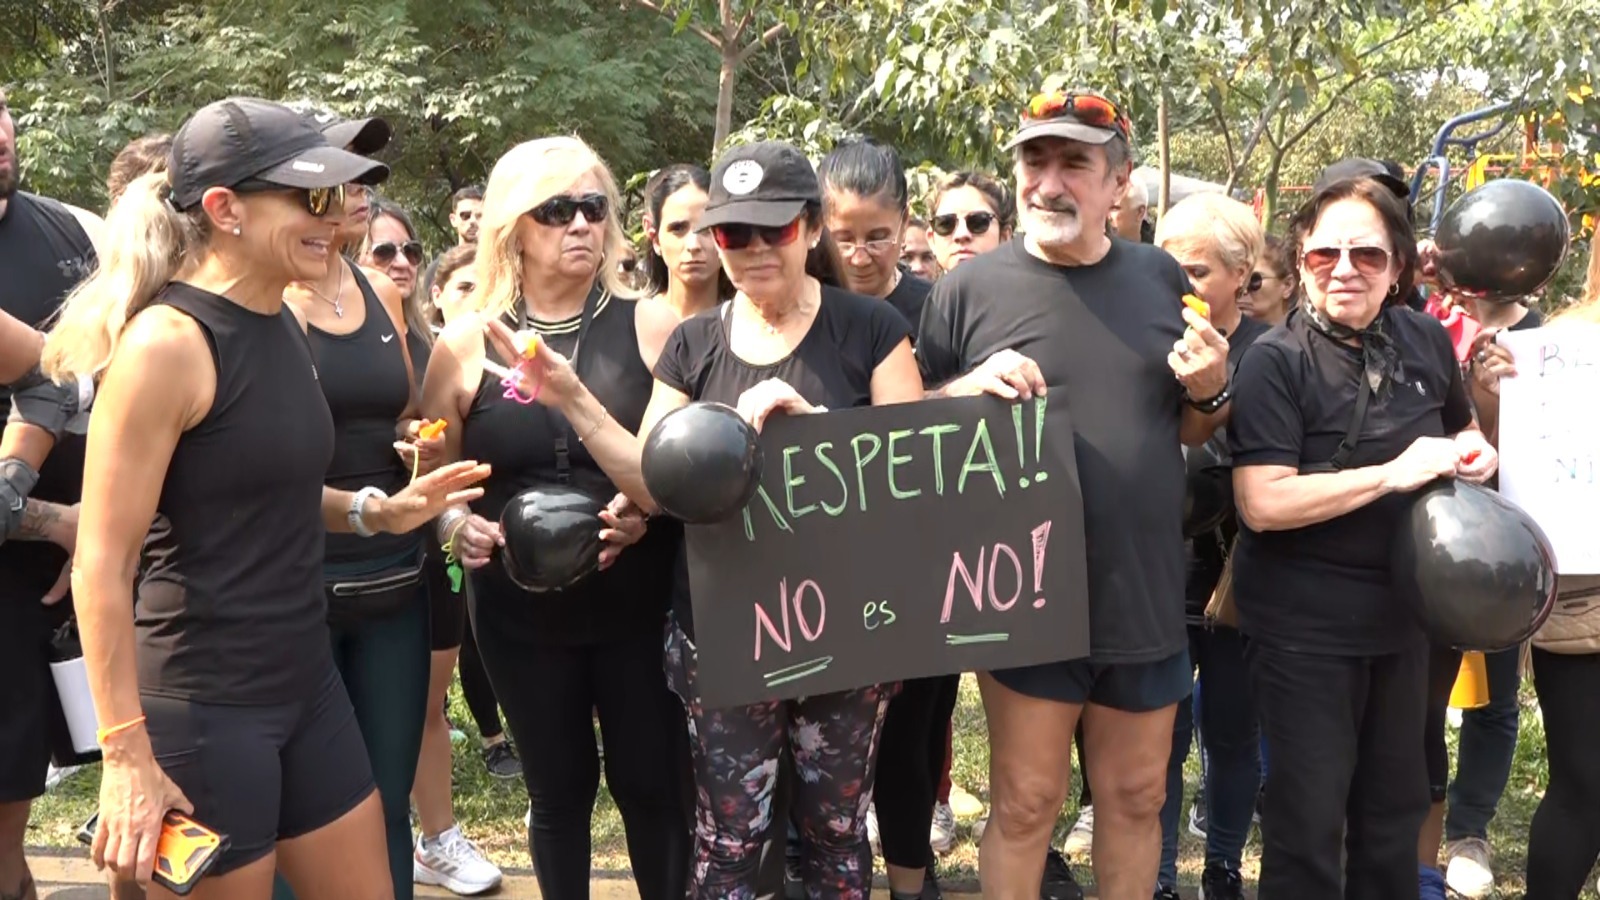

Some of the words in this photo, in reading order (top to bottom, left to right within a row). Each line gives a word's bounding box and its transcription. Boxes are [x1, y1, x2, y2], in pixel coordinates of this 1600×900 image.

[754, 577, 826, 661] NO
[863, 600, 896, 630] es
[940, 520, 1052, 624] NO!
